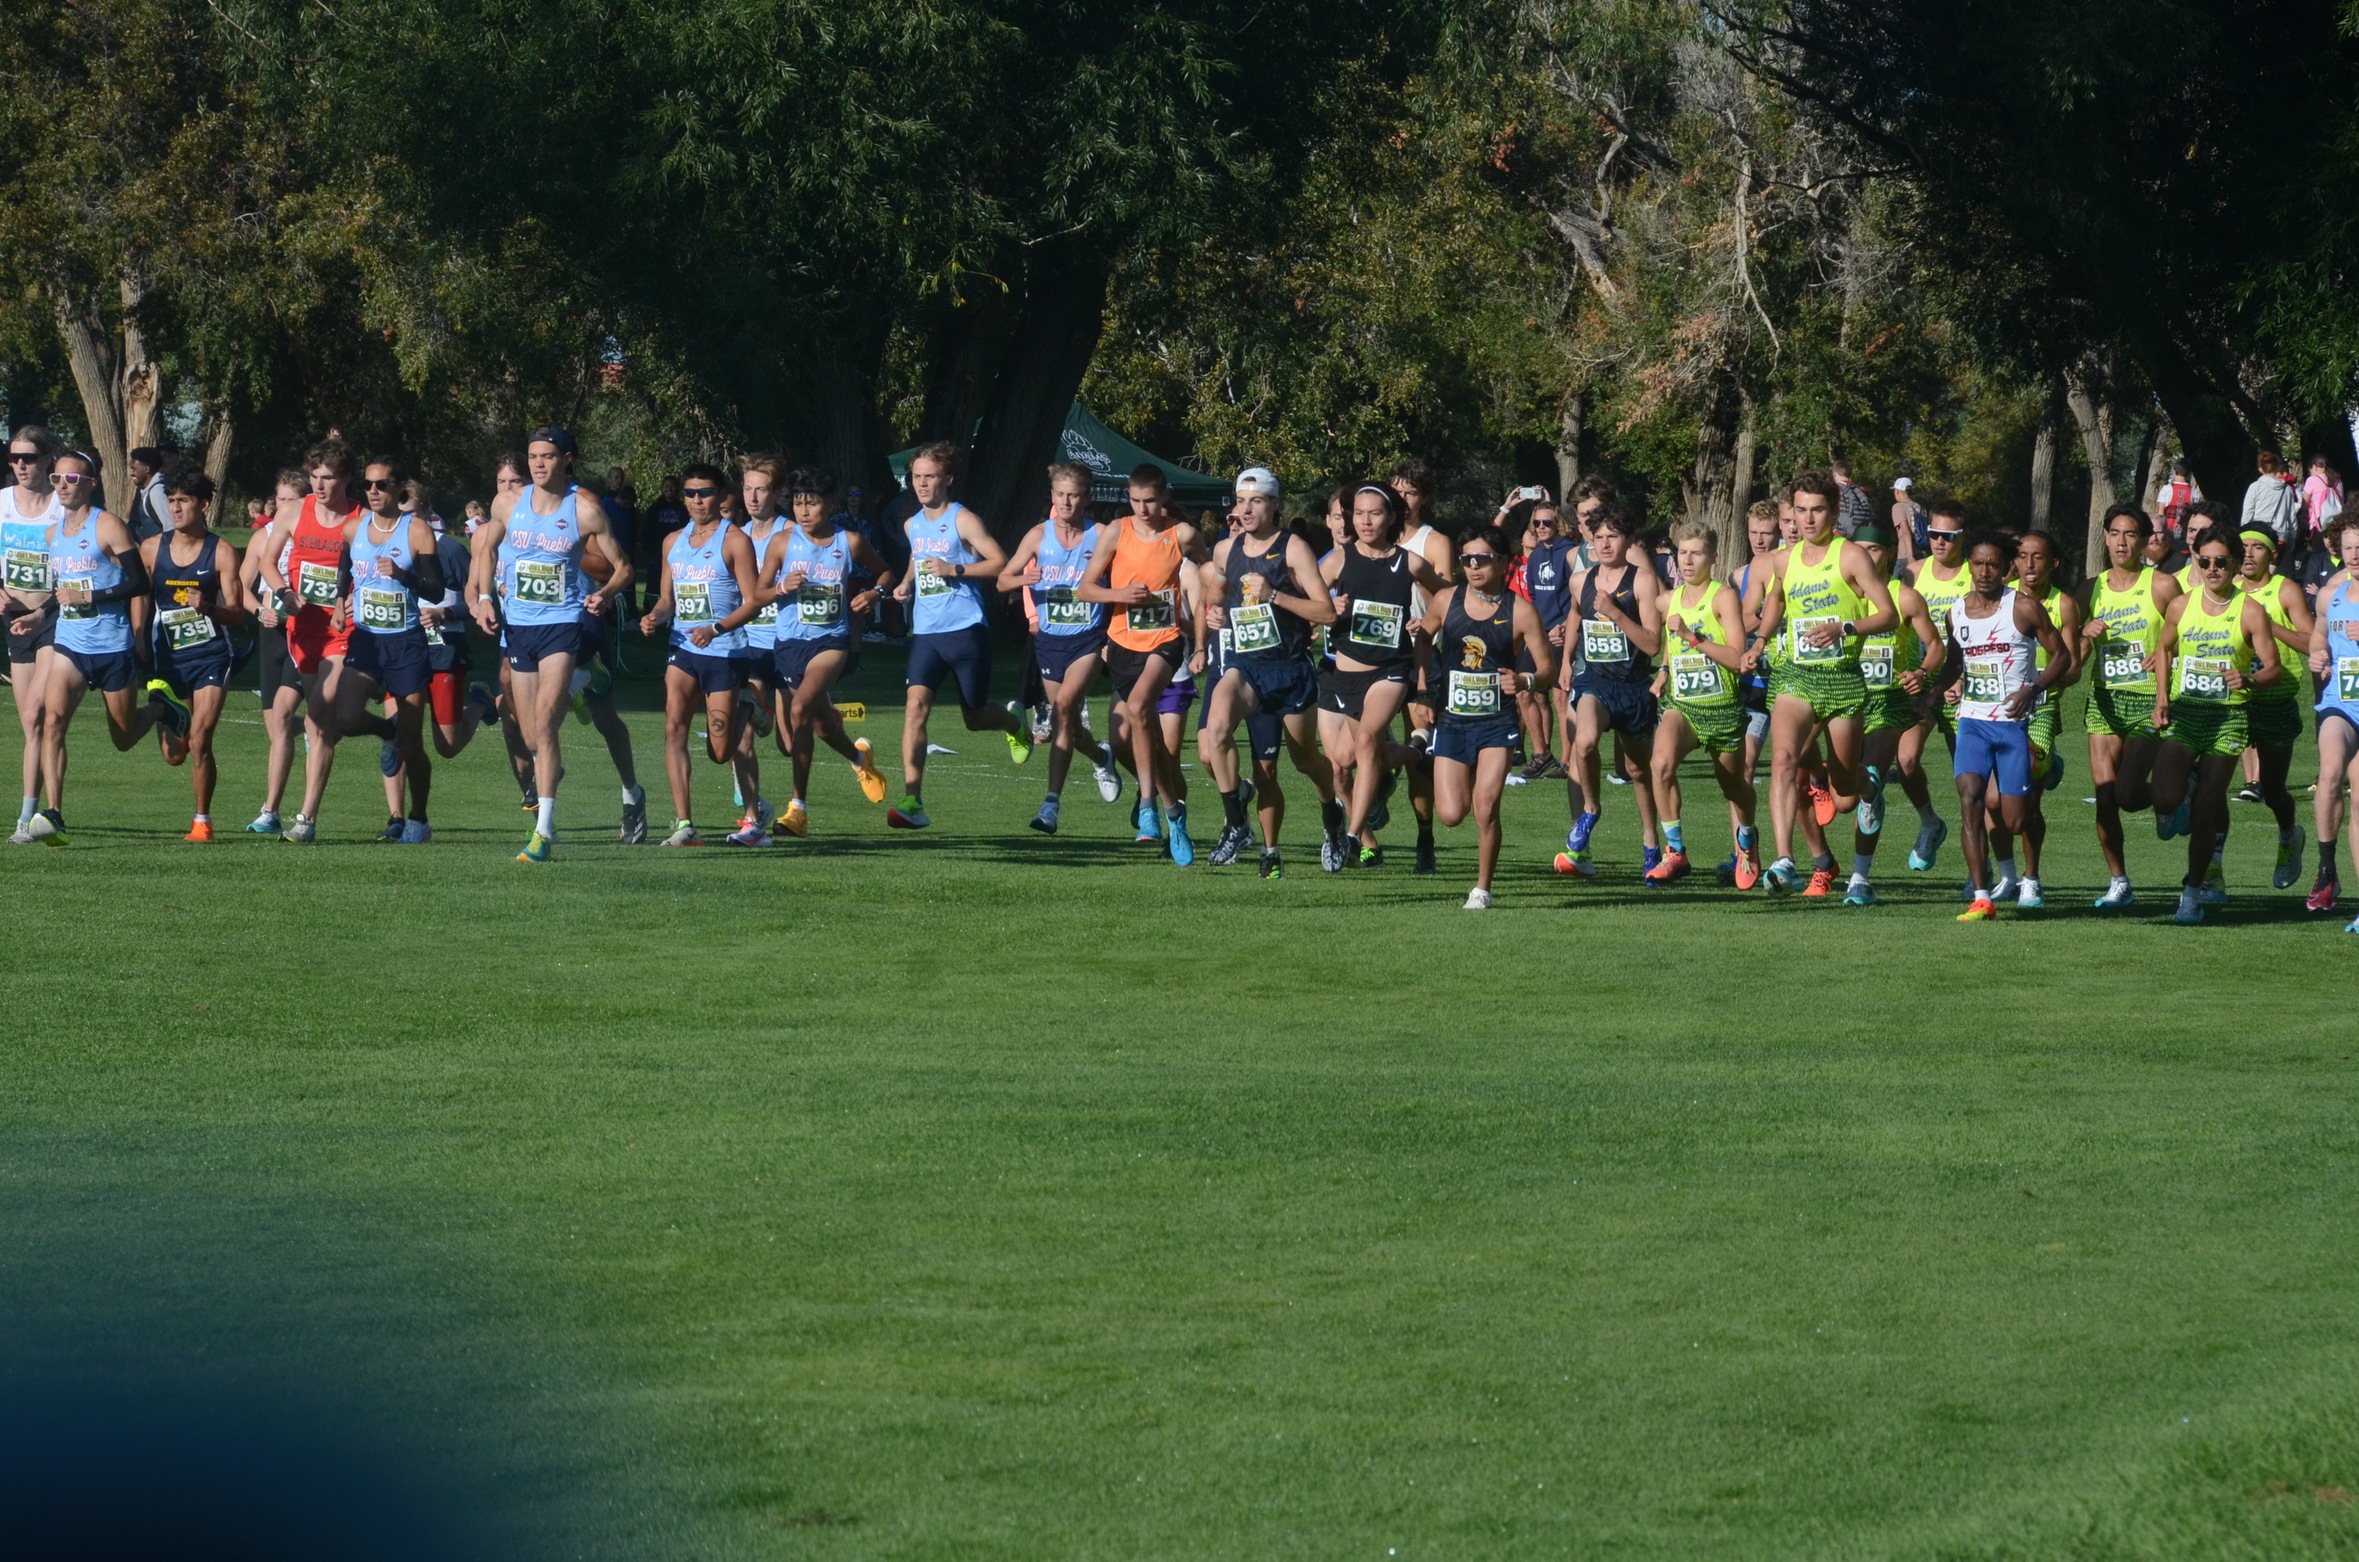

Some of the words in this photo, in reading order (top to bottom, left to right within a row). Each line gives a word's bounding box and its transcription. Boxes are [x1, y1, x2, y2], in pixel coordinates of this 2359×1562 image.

[4, 531, 47, 549] Walmar
[9, 564, 45, 583] 731
[65, 555, 98, 574] Pueblo
[813, 563, 844, 580] Puebl
[165, 579, 199, 587] ABERDEEN
[303, 579, 338, 598] 737
[520, 577, 559, 595] 703
[920, 573, 947, 589] 694
[1788, 579, 1830, 602] Adams
[364, 604, 401, 621] 695
[678, 598, 707, 614] 697
[802, 599, 838, 615] 696
[1051, 602, 1086, 617] 704
[1802, 593, 1839, 614] State
[2096, 603, 2141, 621] Adams
[1131, 606, 1169, 623] 717
[169, 620, 208, 640] 735
[1238, 621, 1270, 642] 657
[1357, 617, 1396, 637] 769
[2110, 618, 2149, 637] State
[2182, 626, 2230, 643] Adams
[1588, 637, 1622, 653] 658
[2196, 642, 2235, 658] State
[1861, 662, 1888, 678] 90
[2105, 658, 2142, 677] 686
[1678, 670, 1715, 690] 679
[1967, 677, 1999, 694] 738
[2185, 673, 2225, 692] 684
[1454, 688, 1495, 706] 659
